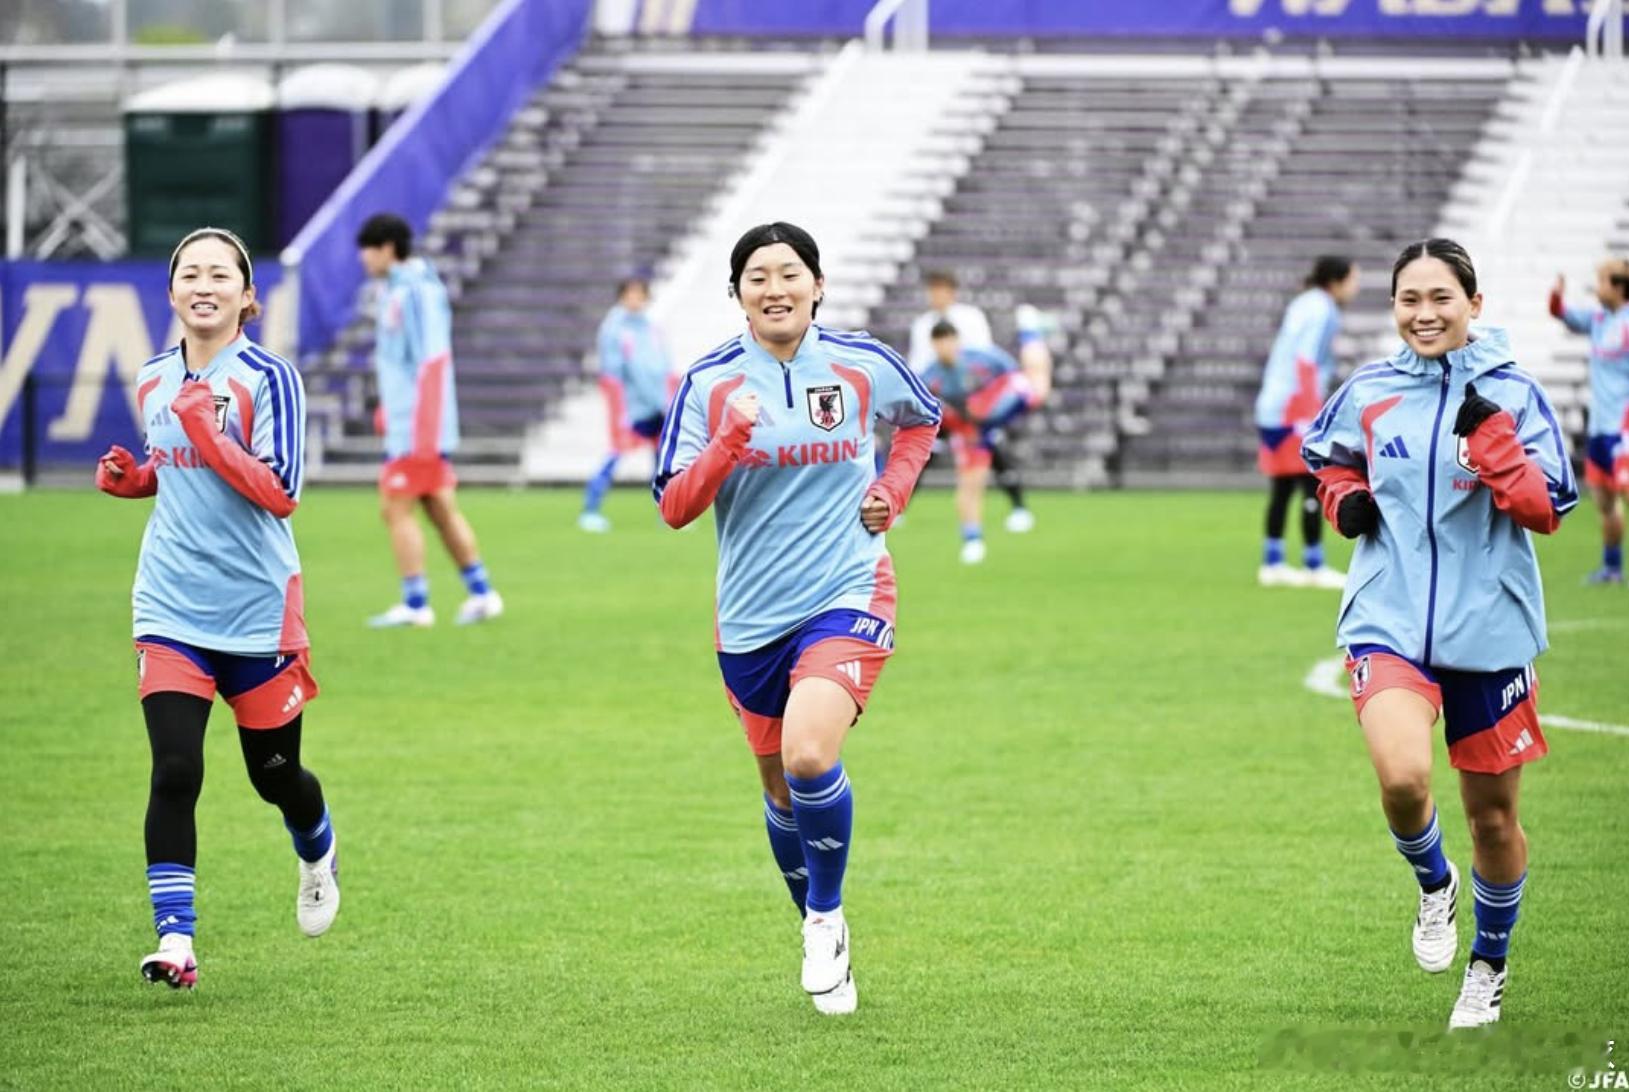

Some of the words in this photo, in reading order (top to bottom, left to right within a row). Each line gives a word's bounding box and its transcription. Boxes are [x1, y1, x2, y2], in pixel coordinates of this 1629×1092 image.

[173, 447, 205, 469] KI
[778, 438, 858, 469] KIRIN
[849, 616, 880, 637] JPN
[1501, 673, 1525, 711] JPN
